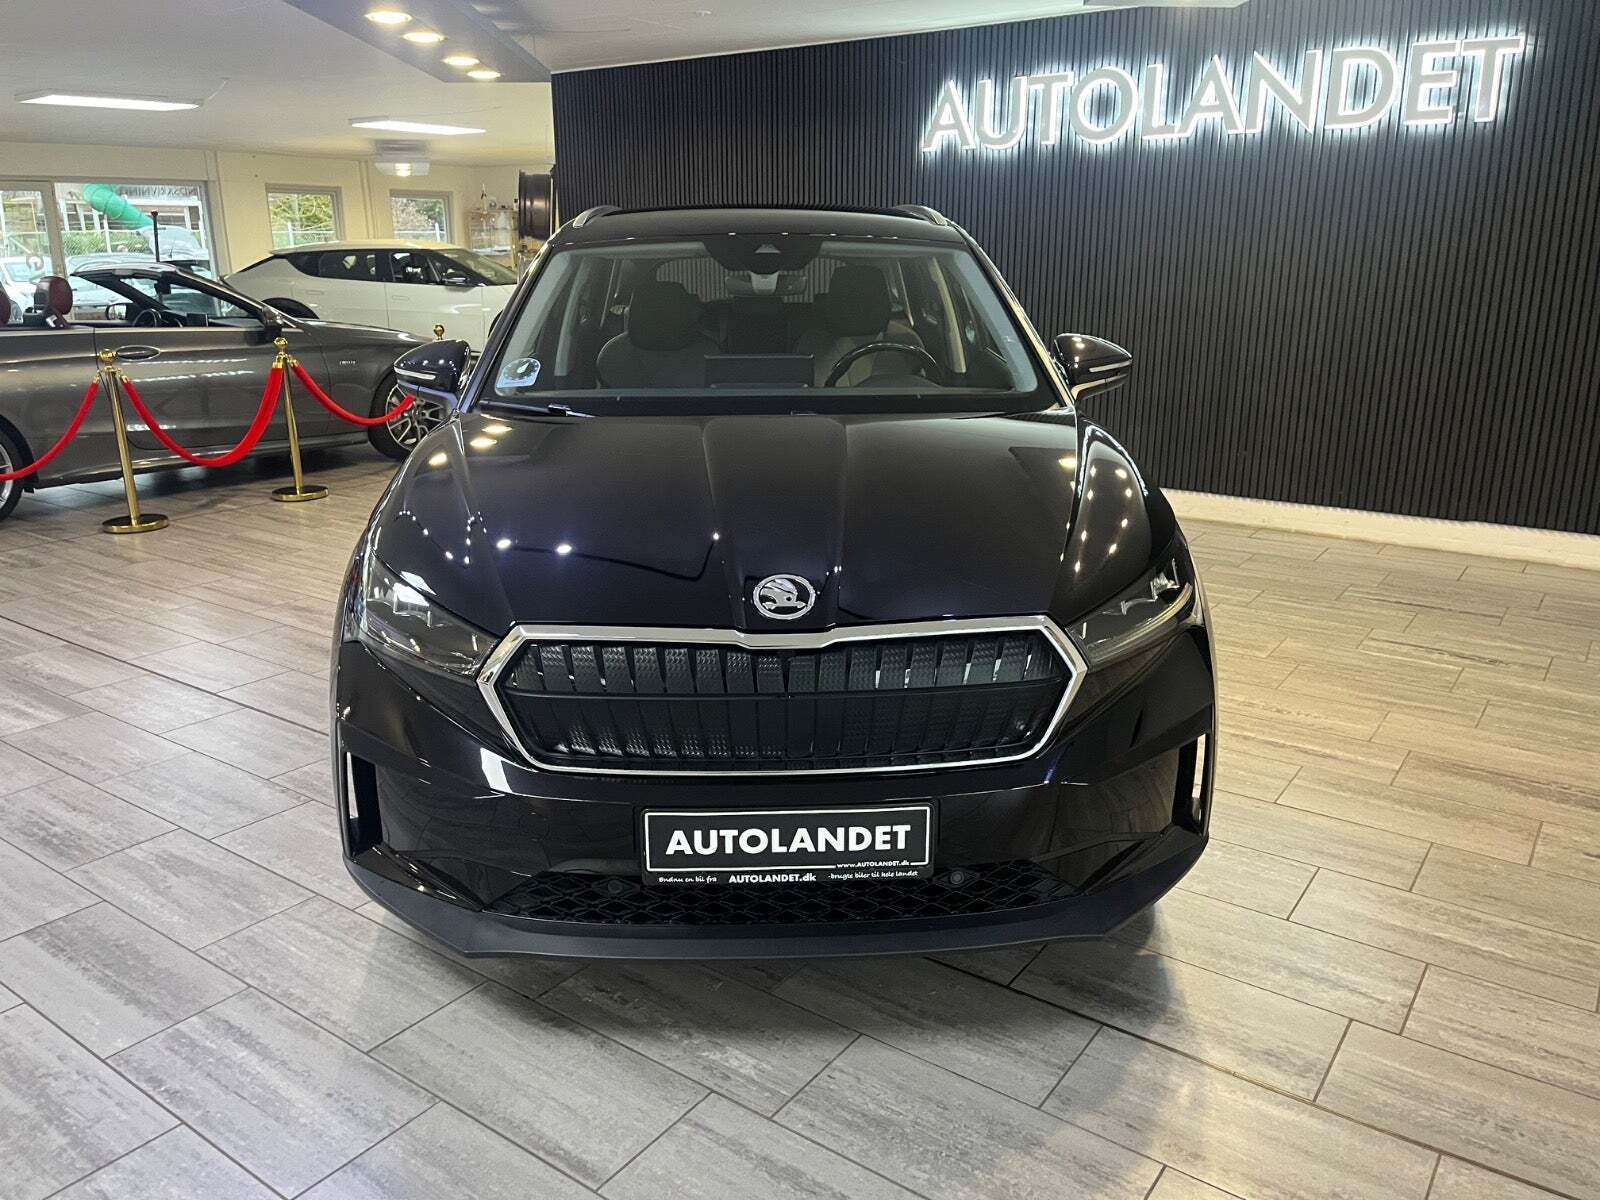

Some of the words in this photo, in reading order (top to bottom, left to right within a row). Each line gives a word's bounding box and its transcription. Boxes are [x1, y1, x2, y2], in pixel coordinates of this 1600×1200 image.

[921, 36, 1525, 151] AUTOLANDET
[665, 824, 911, 856] AUTOLANDET
[836, 860, 910, 868] www.AUTOLANDET.dk
[706, 875, 717, 884] fra
[728, 873, 817, 883] AUTOLANDET.dk
